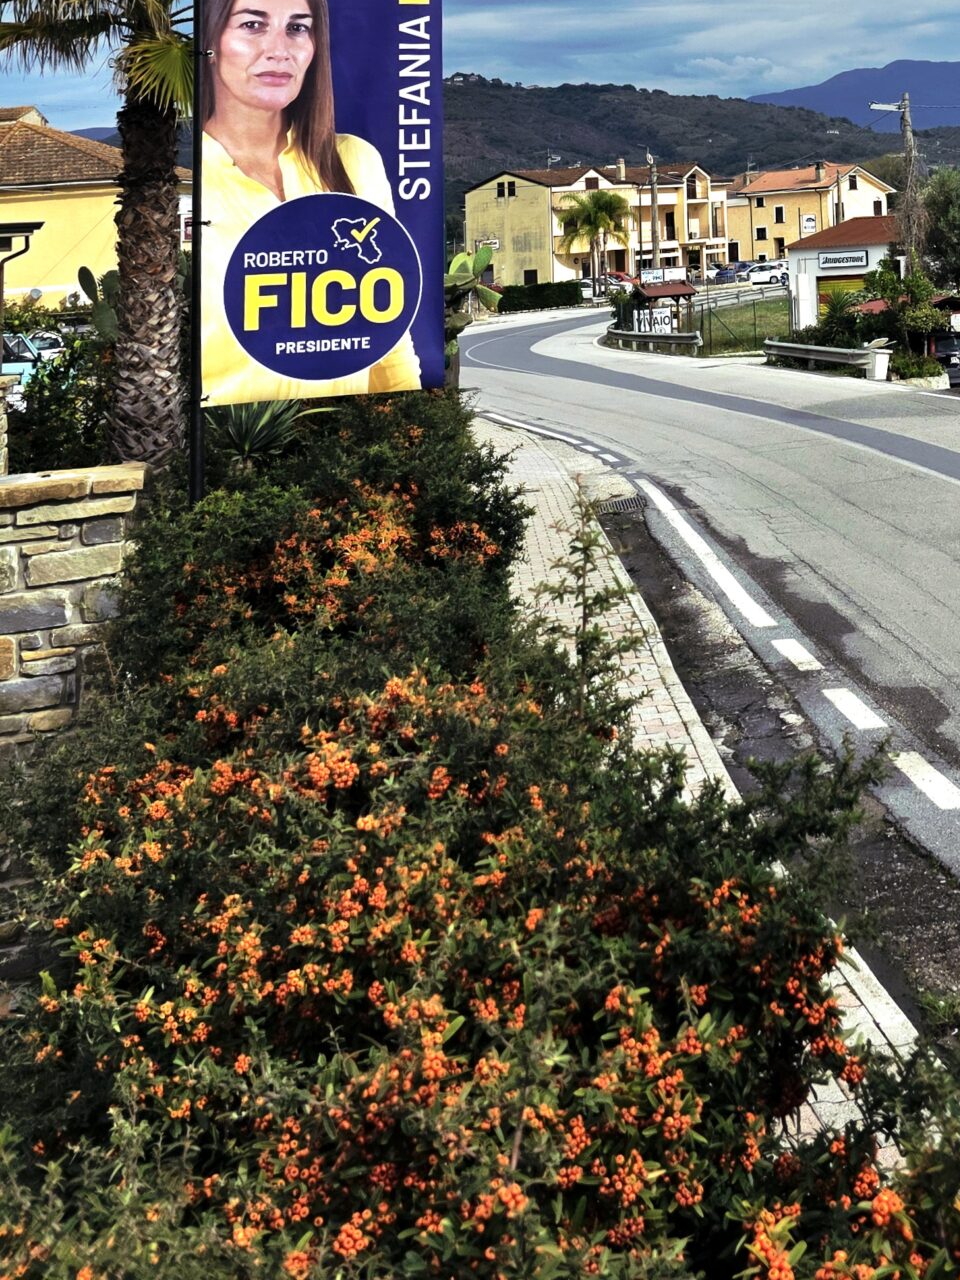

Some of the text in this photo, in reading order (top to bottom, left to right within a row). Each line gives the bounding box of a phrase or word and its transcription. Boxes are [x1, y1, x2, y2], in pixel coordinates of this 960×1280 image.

[398, 15, 431, 201] STEFANIA
[243, 249, 329, 268] ROBERTO
[243, 267, 405, 331] FICO
[636, 315, 671, 327] VVAIO
[275, 336, 371, 355] PRESIDENTE
